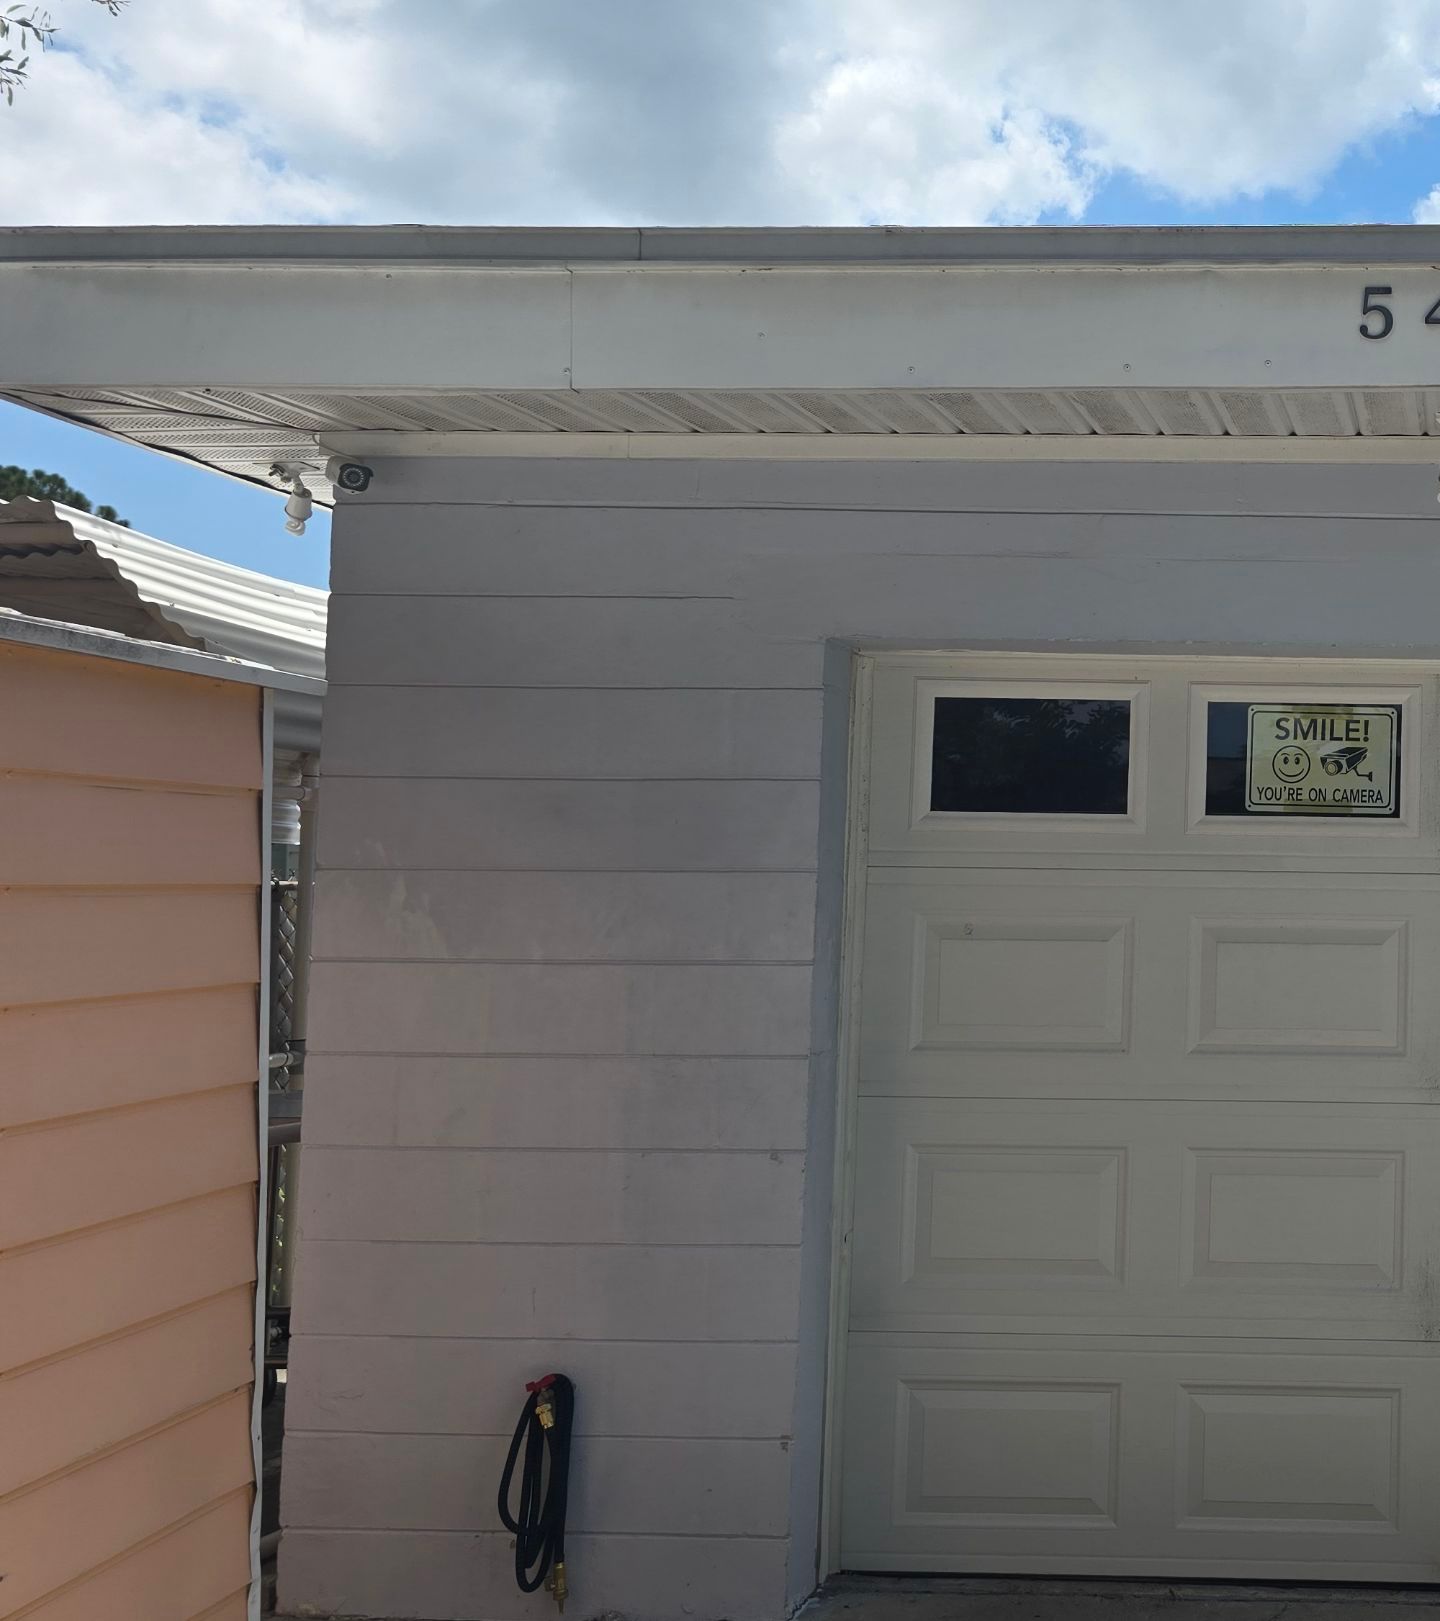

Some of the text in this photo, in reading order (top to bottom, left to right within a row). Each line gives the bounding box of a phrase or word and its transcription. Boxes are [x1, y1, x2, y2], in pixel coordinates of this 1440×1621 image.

[1275, 717, 1370, 742] SMILE!
[1257, 786, 1384, 803] YOU'RE ON CAMERA
